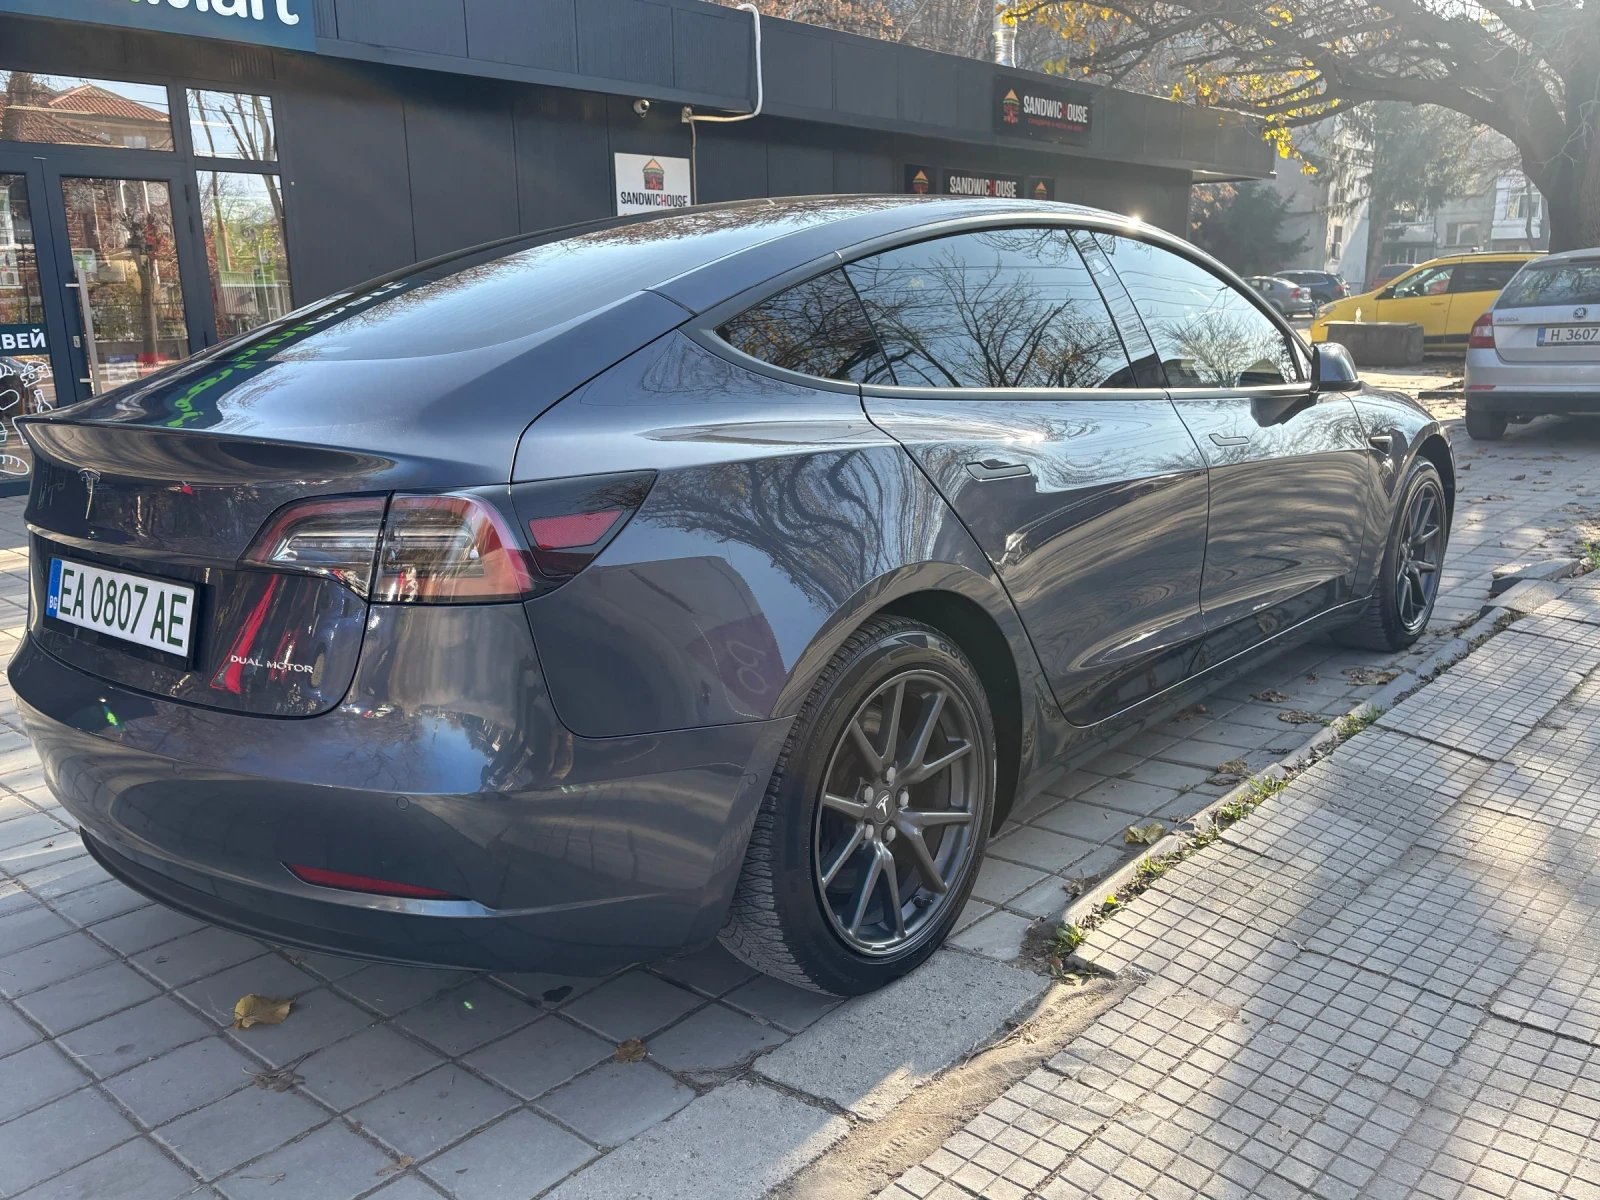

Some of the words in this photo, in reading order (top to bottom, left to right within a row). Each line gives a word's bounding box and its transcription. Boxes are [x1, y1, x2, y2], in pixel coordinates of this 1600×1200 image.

[1023, 95, 1088, 123] SANDWICHOUSE
[950, 176, 1017, 198] SANDWICHOUSE
[621, 192, 688, 207] SANDWICHOUSE
[0, 329, 46, 350] ВЕЙ
[1566, 328, 1599, 341] 3607
[49, 595, 58, 610] BG
[60, 568, 84, 619] EA
[91, 576, 148, 634] 0807
[150, 591, 187, 647] AE
[230, 655, 263, 667] DUAL
[266, 660, 314, 674] MOTOR
